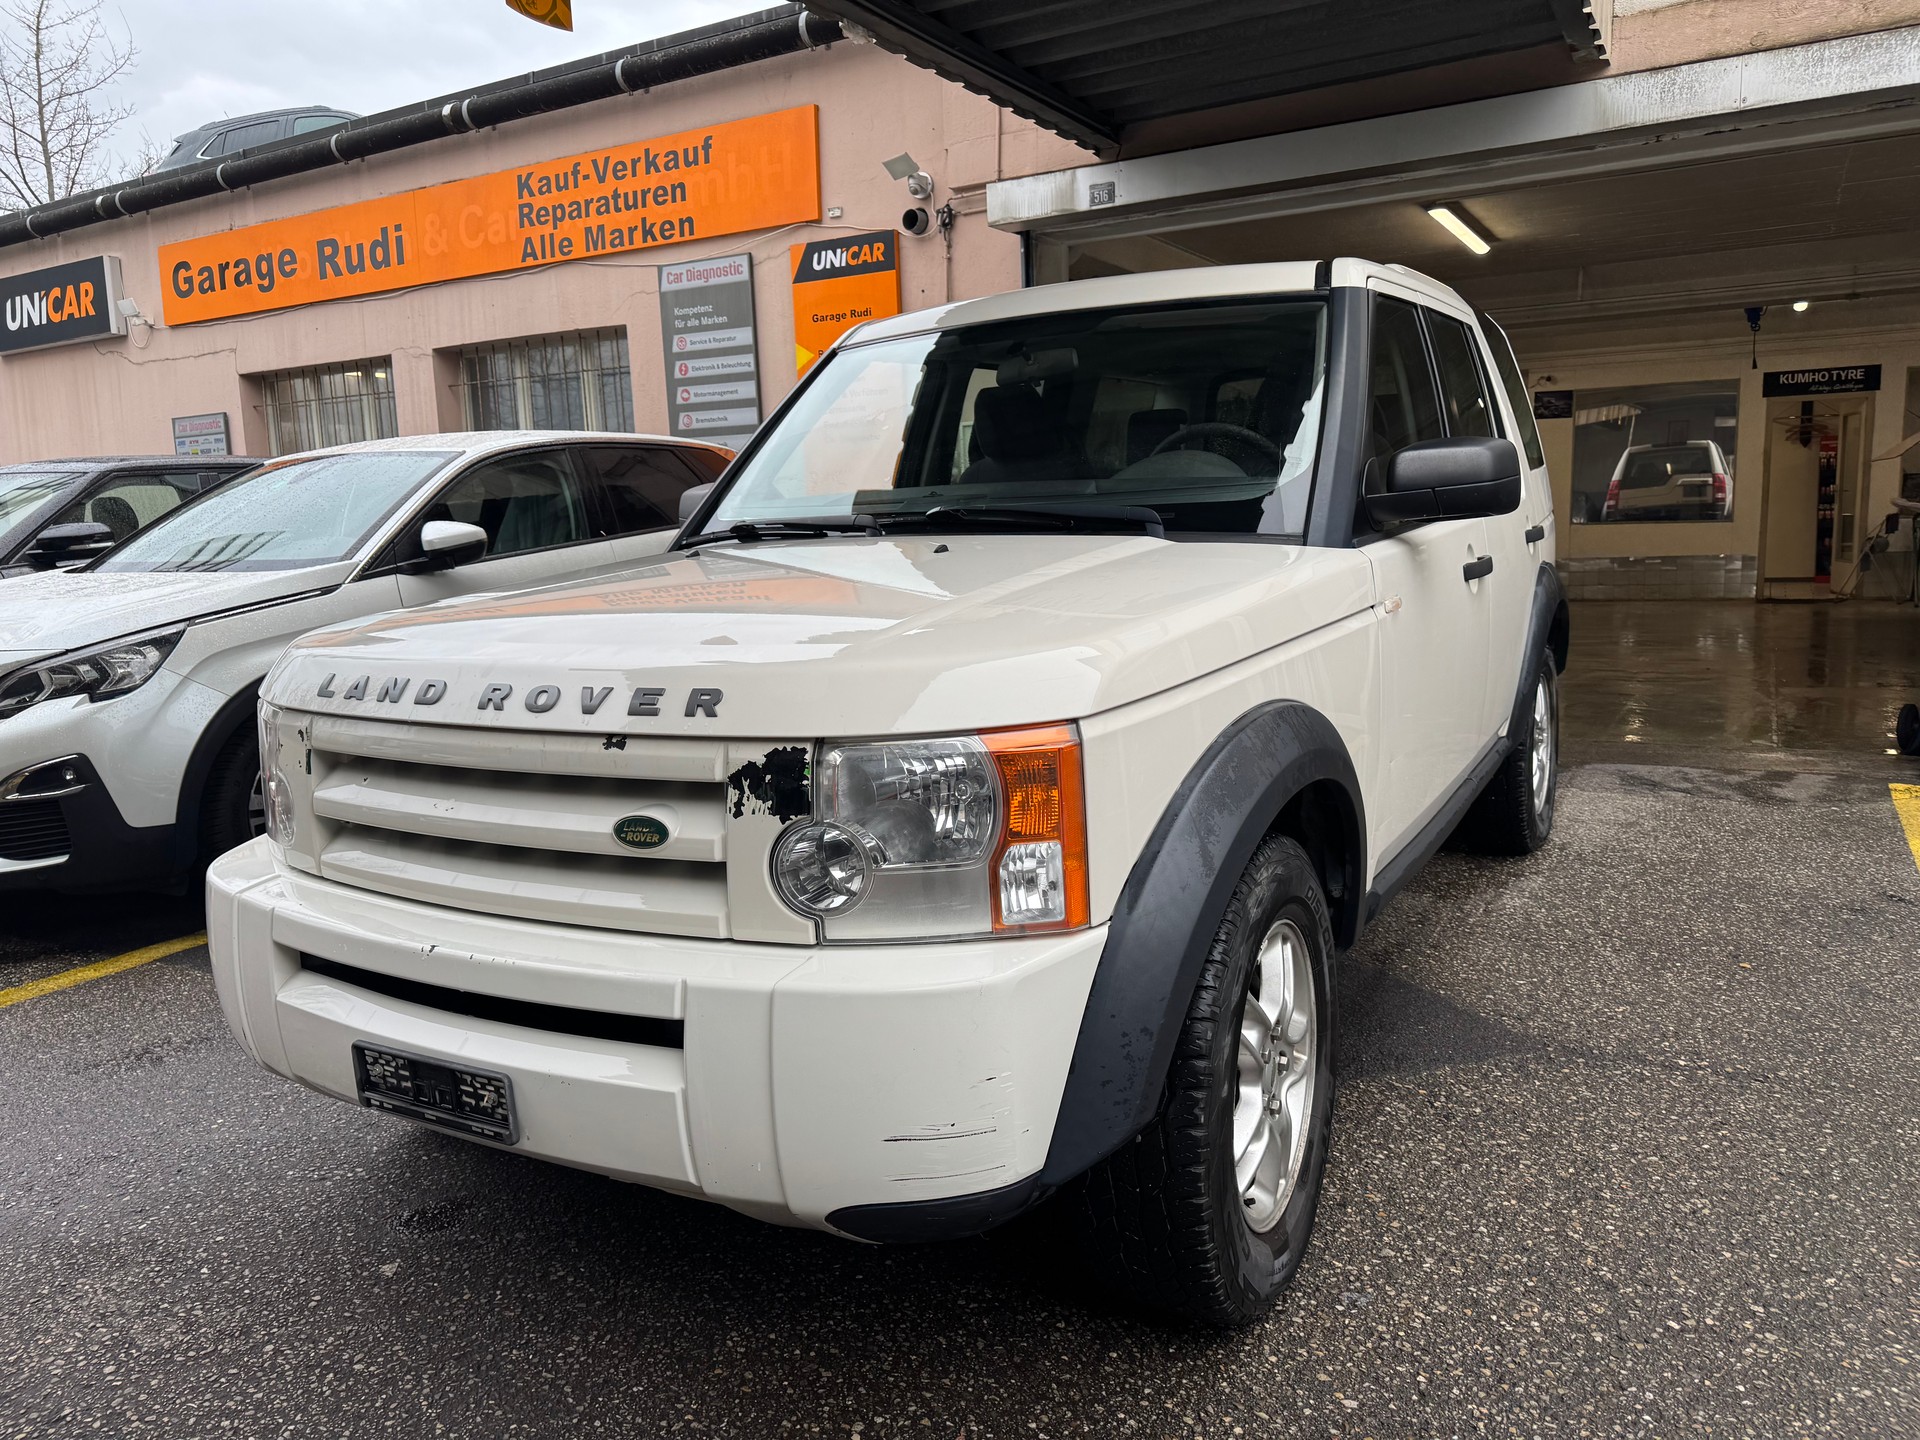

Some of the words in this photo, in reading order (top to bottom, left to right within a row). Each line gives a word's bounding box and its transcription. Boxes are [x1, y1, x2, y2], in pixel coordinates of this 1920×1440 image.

[516, 135, 714, 200] Kauf-Verkauf
[1094, 190, 1108, 203] 516
[517, 181, 688, 229] Reparaturen
[520, 228, 574, 263] Alle
[584, 215, 696, 253] Marken
[171, 247, 299, 300] Garage
[315, 223, 406, 281] Rudi
[666, 271, 684, 285] Car
[686, 261, 744, 283] Diagnostic
[673, 305, 713, 316] Kompetenz
[812, 312, 847, 323] Garage
[850, 307, 872, 319] Rudi
[674, 319, 686, 329] für
[686, 318, 700, 327] alle
[701, 315, 728, 326] Marken
[712, 336, 736, 344] Reparatur
[691, 363, 716, 372] Elektronik
[721, 361, 752, 370] Beleuchtung
[1780, 371, 1829, 384] KUMHO
[1831, 369, 1865, 381] TYRE
[693, 389, 739, 397] Motormanagement
[695, 416, 728, 424] Bremstechnik
[316, 672, 449, 706] LAND
[477, 682, 725, 718] ROVER
[623, 821, 650, 831] LAND
[626, 832, 660, 843] ROVER
